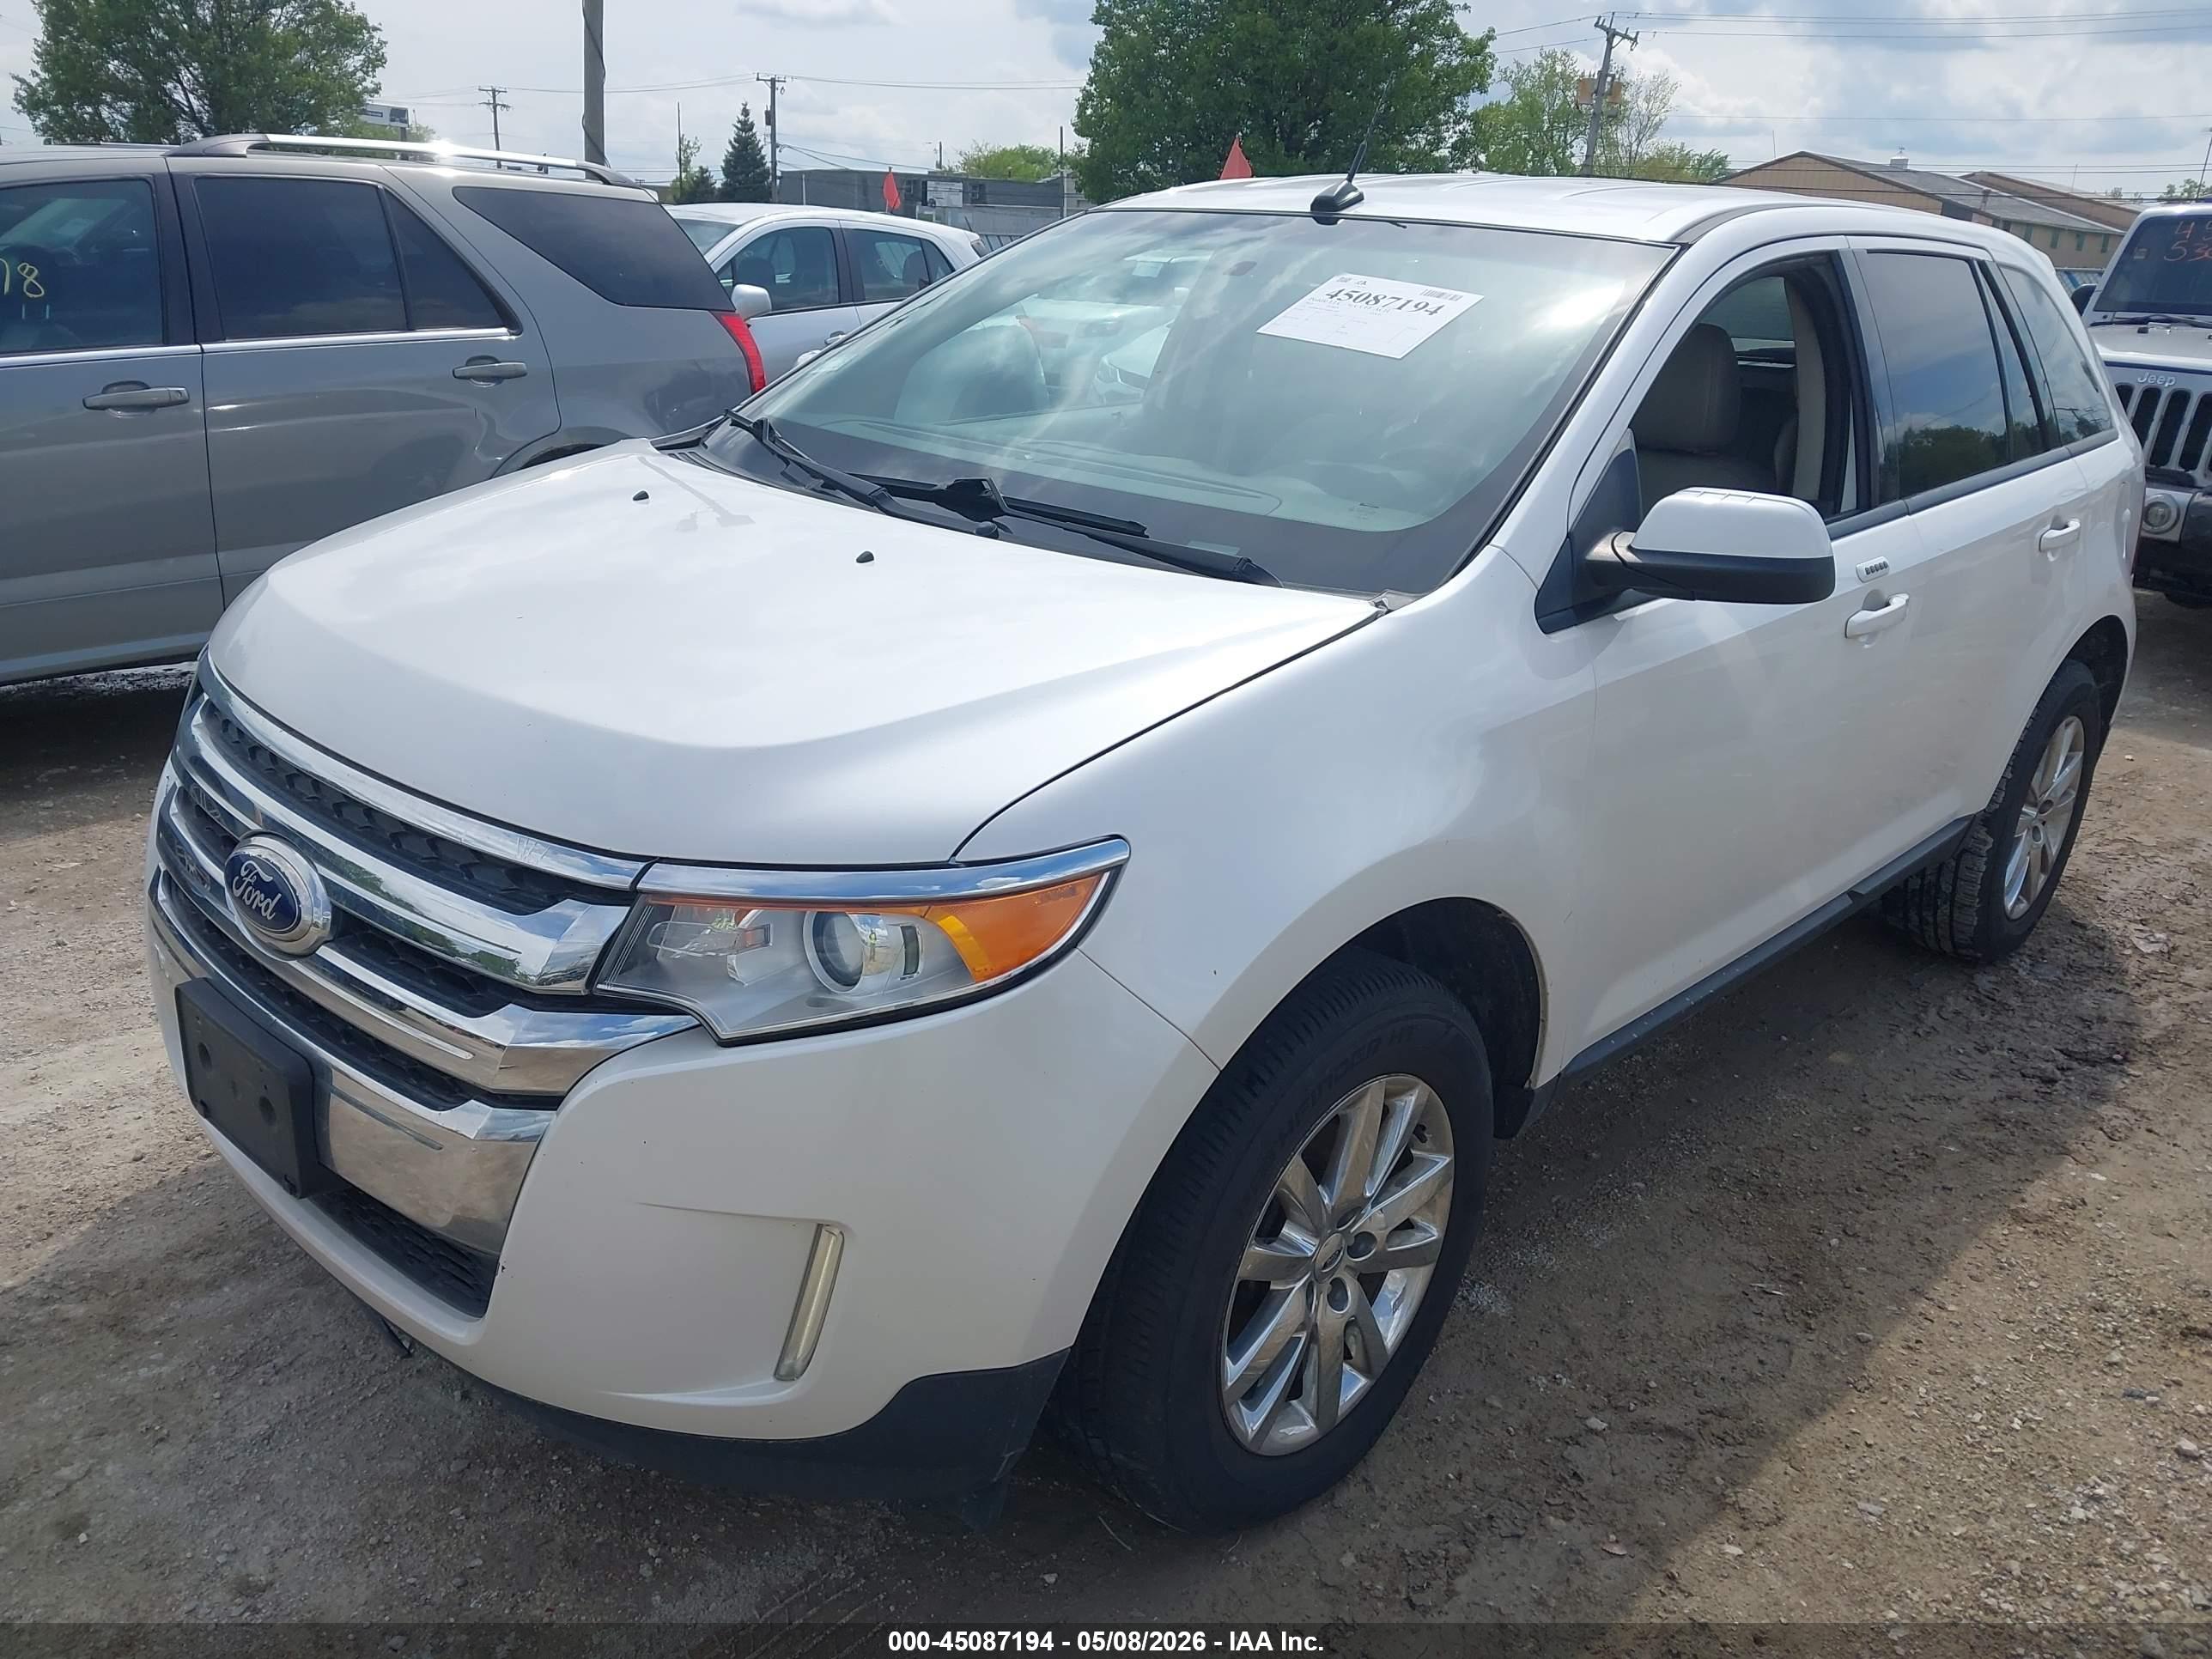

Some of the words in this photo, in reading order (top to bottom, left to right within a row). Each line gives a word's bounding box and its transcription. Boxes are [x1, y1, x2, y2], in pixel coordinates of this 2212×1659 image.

[1325, 288, 1445, 316] 45087194
[2136, 371, 2177, 387] Jeep
[232, 860, 282, 921] Ford
